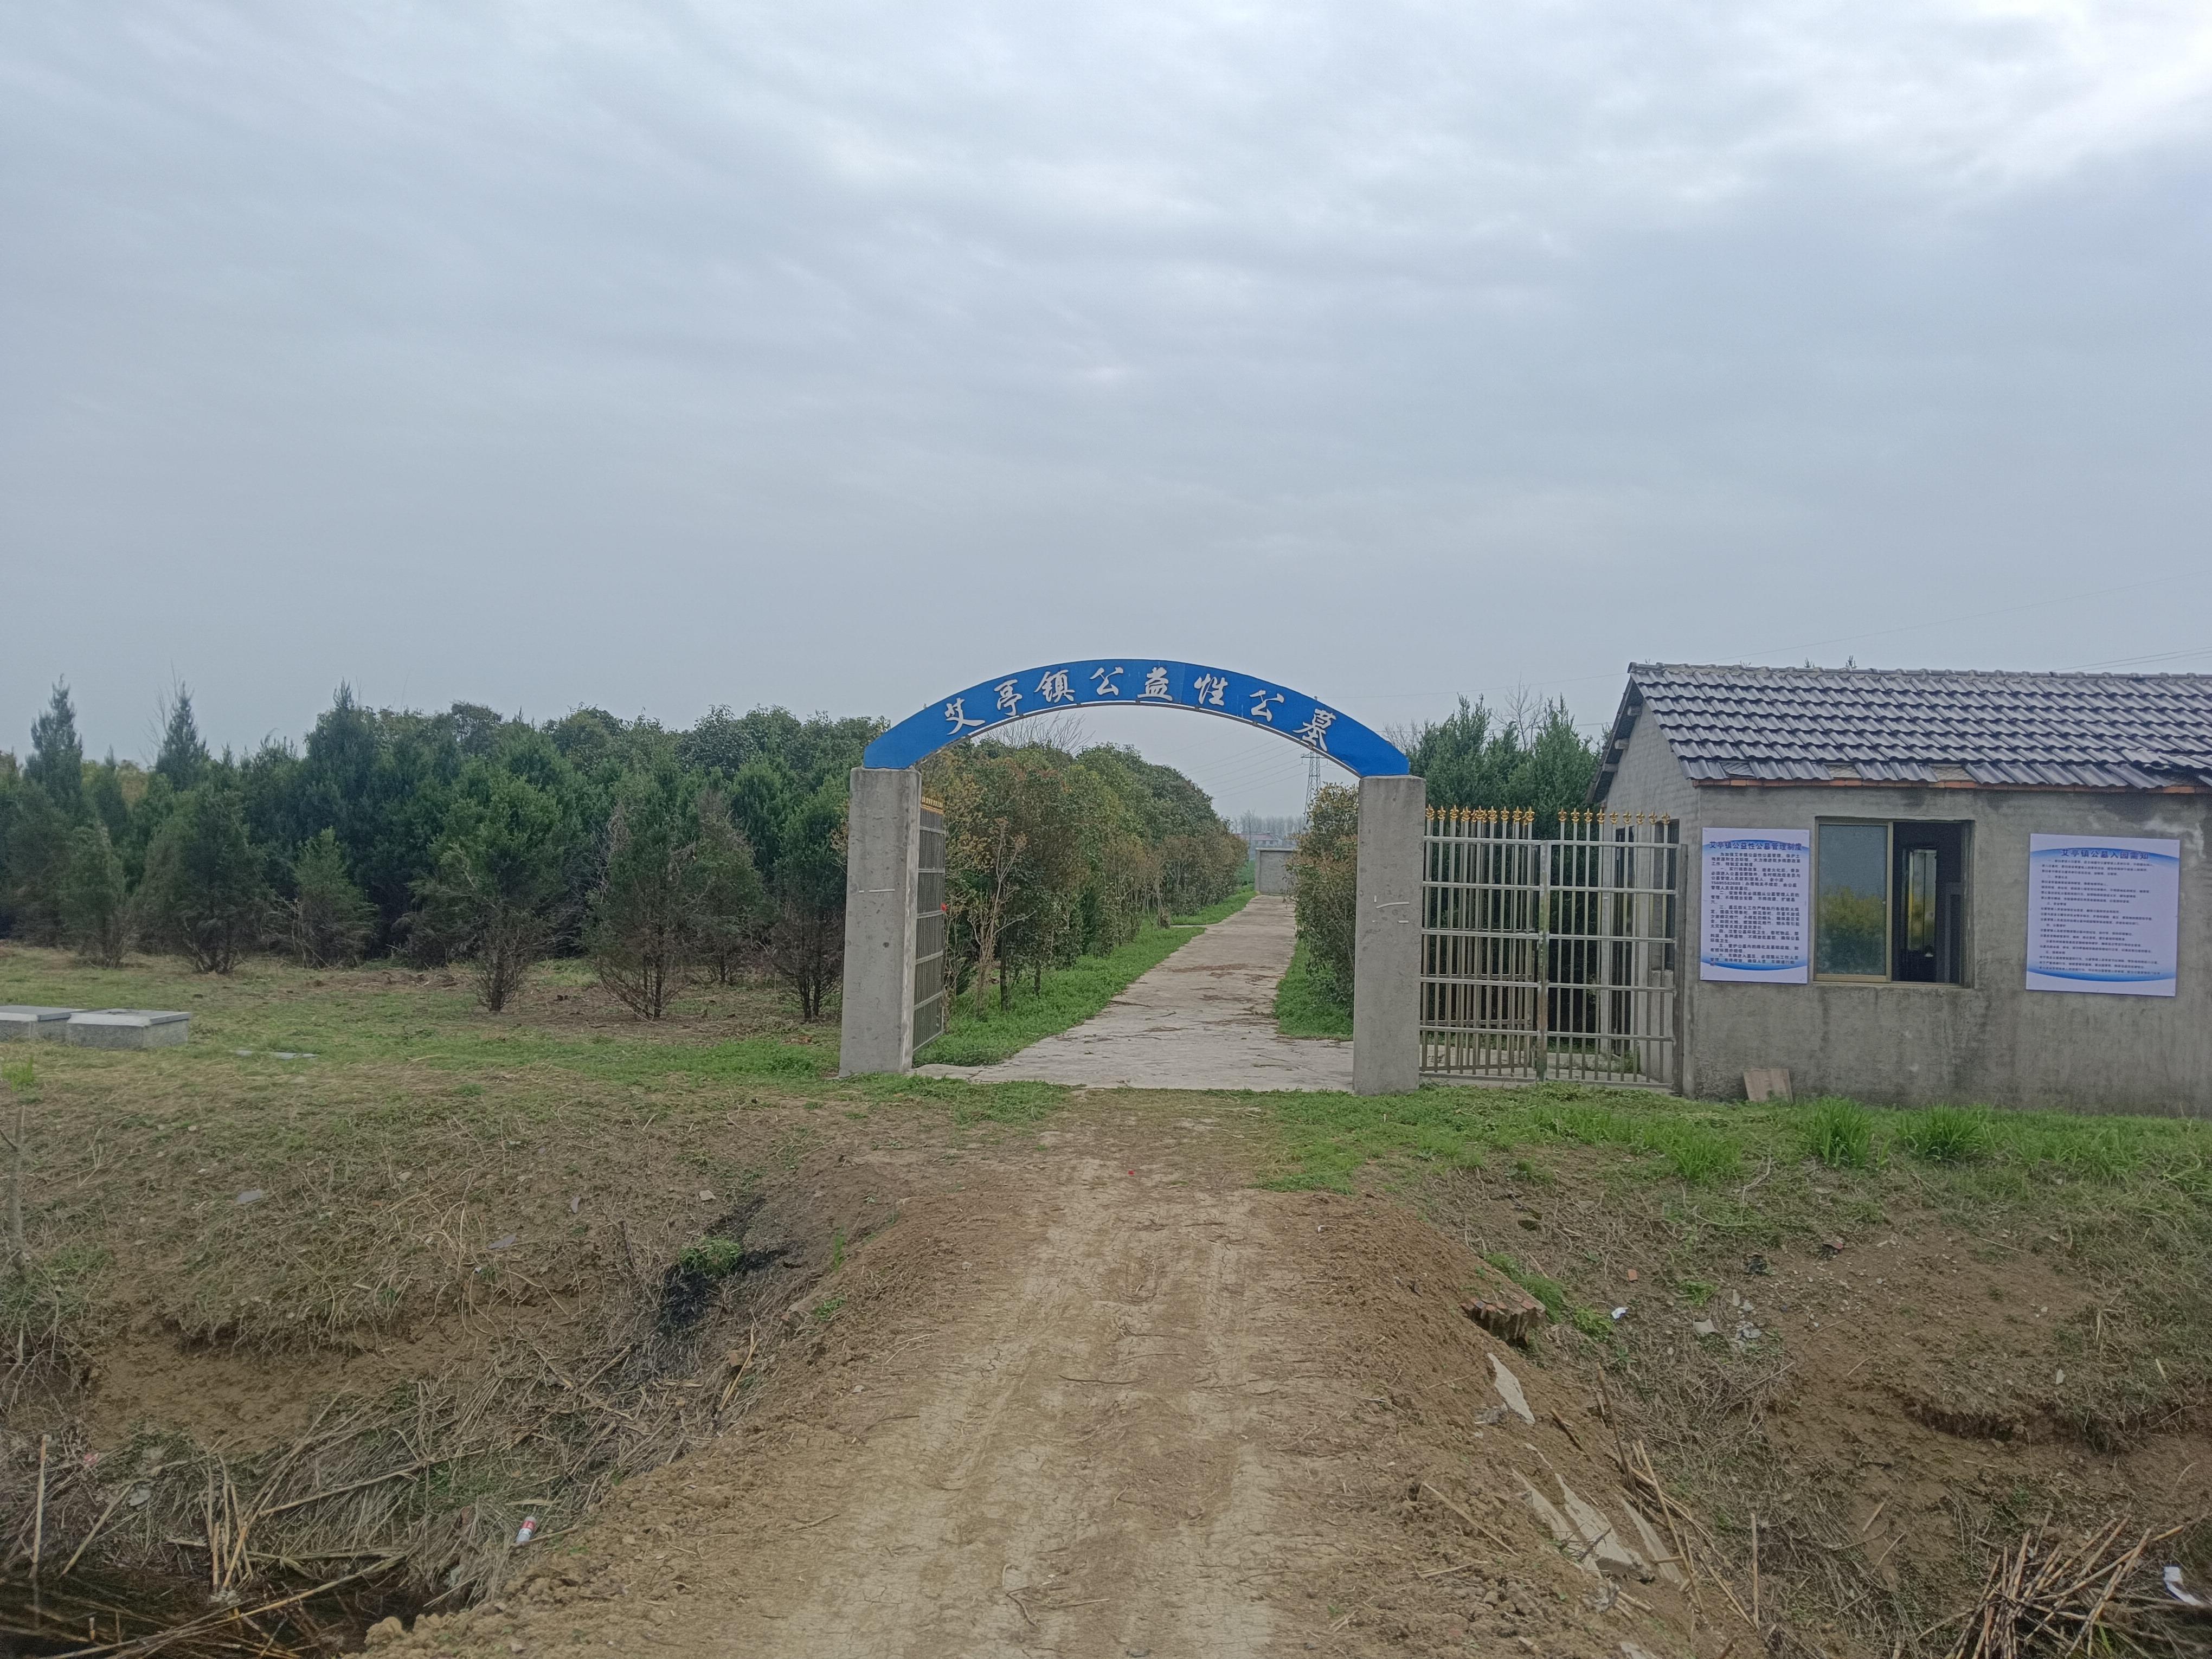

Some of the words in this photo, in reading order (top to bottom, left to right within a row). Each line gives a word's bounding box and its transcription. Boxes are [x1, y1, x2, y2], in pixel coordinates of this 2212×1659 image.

[944, 666, 1336, 751] 艾亭镇公益性公墓
[1709, 841, 1802, 851] 艾亭镇公益性公墓管理制度
